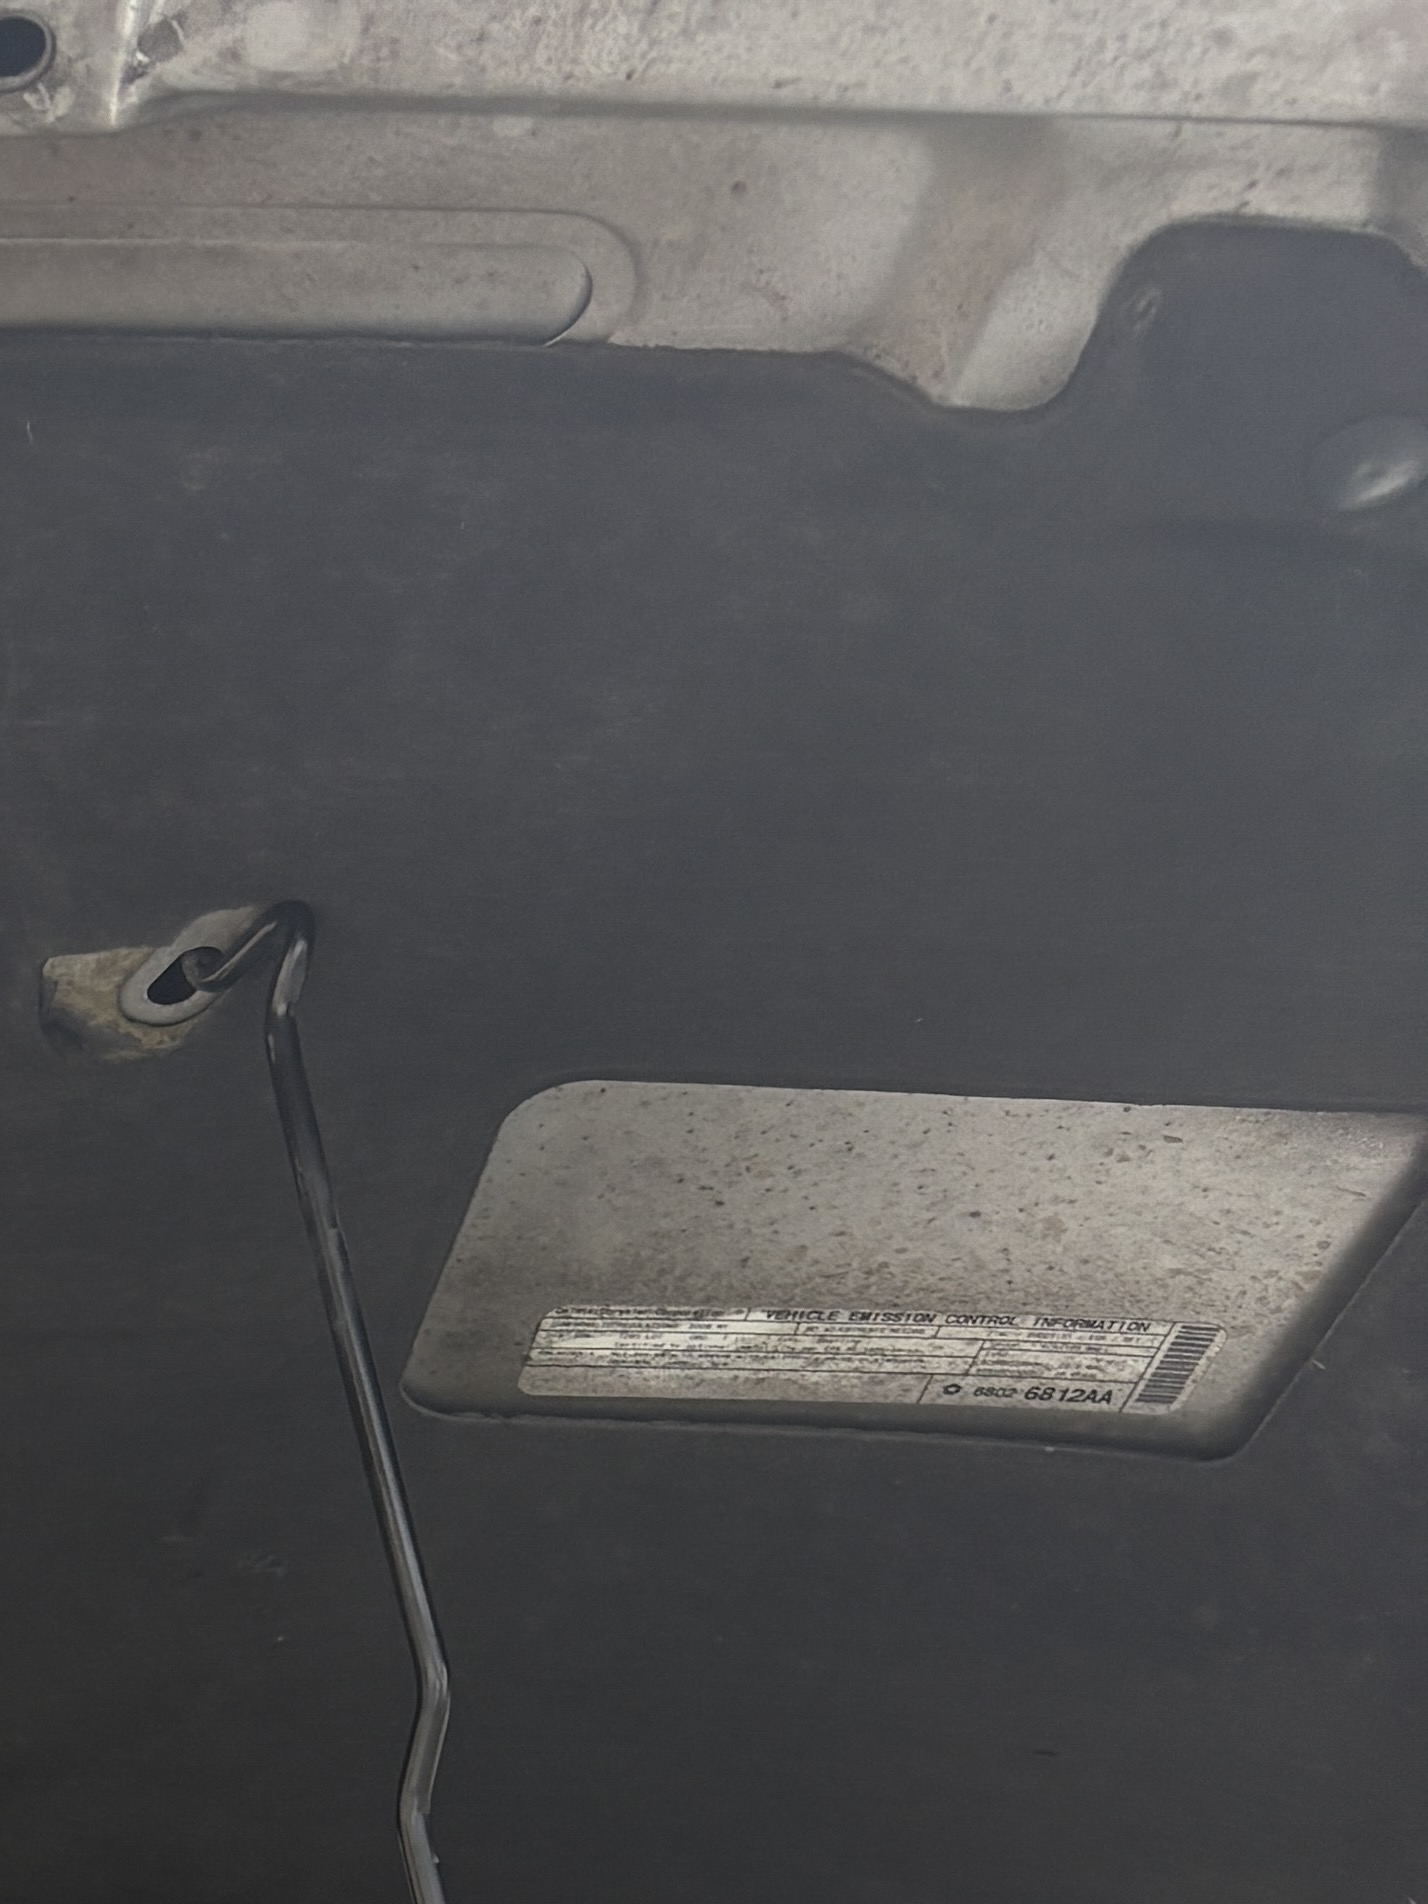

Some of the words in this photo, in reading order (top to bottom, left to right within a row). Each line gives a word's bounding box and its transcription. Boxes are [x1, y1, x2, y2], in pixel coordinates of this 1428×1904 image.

[765, 1309, 842, 1321] VEHICLE
[848, 1310, 937, 1323] EMISSION
[944, 1313, 1017, 1325] CONTROL
[1033, 1316, 1152, 1331] INFORMATION
[1024, 1386, 1114, 1404] 6812AA
